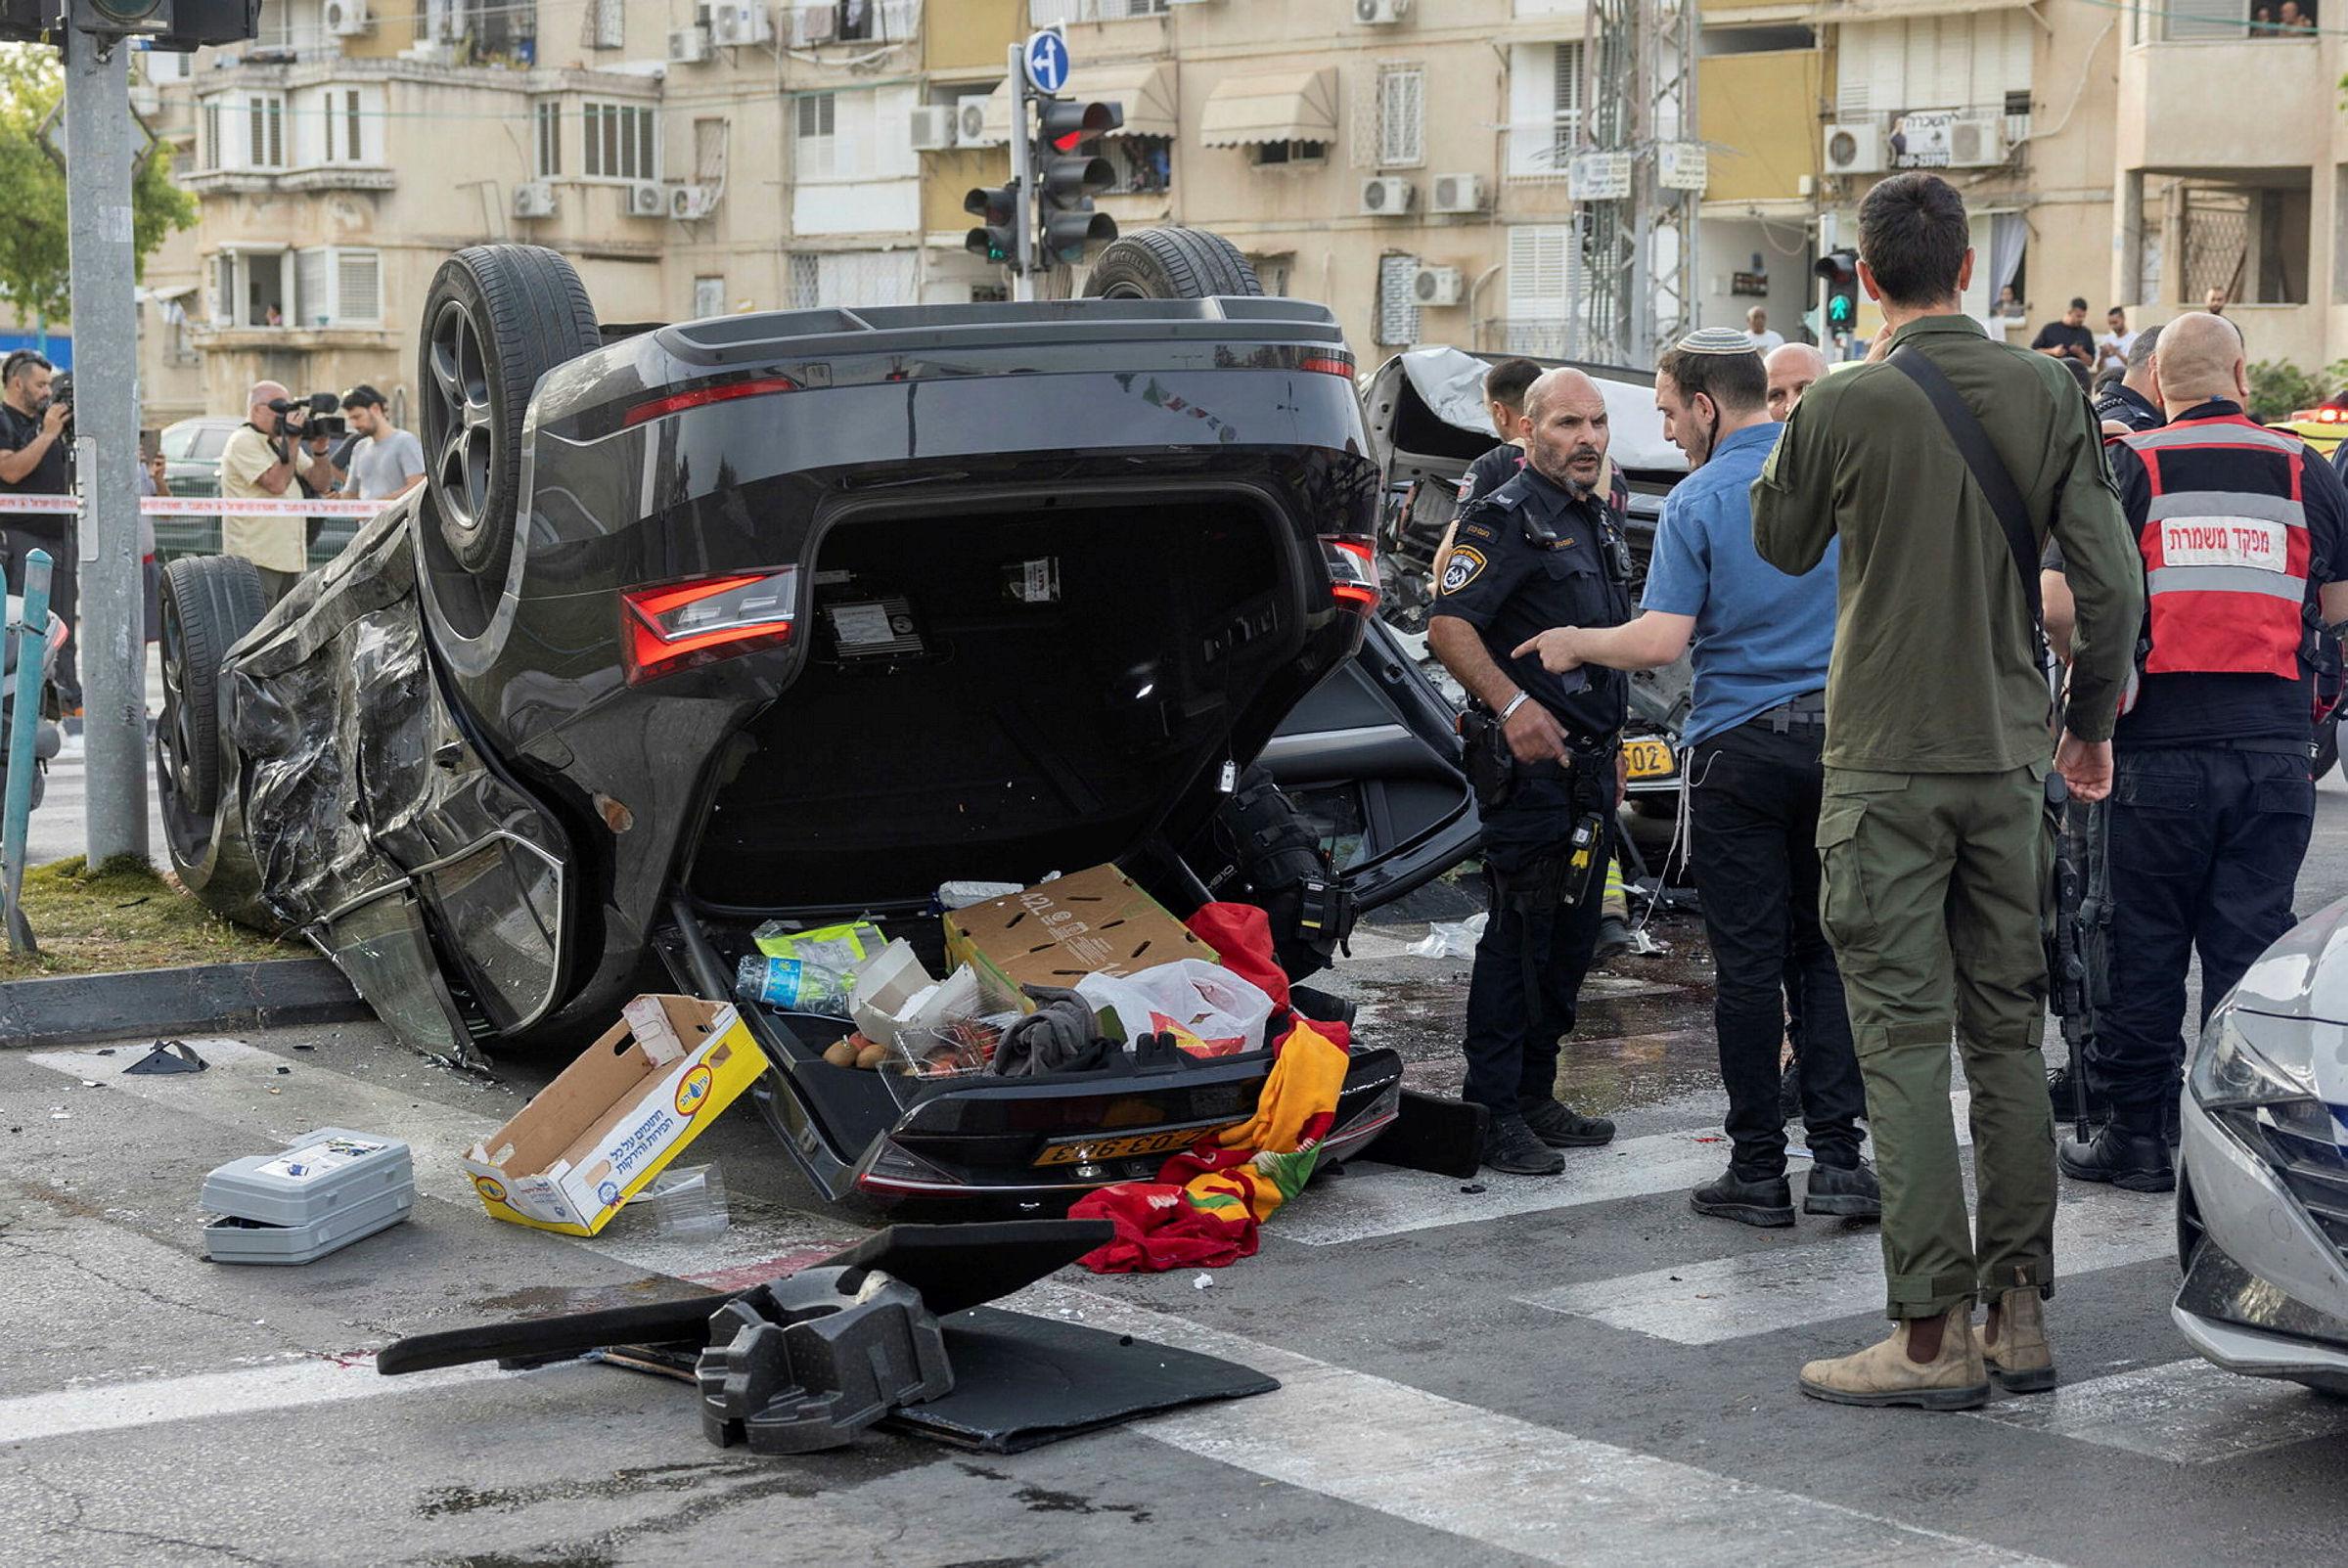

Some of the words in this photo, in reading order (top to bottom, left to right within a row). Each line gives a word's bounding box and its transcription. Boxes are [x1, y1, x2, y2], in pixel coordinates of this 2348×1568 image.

[2168, 527, 2228, 550] משמרת
[2233, 528, 2270, 558] מפקד
[634, 1109, 664, 1140] חתומים
[648, 1117, 674, 1146] הפירות
[610, 1147, 623, 1161] כל
[616, 1142, 648, 1174] והירקות
[620, 1137, 635, 1150] על
